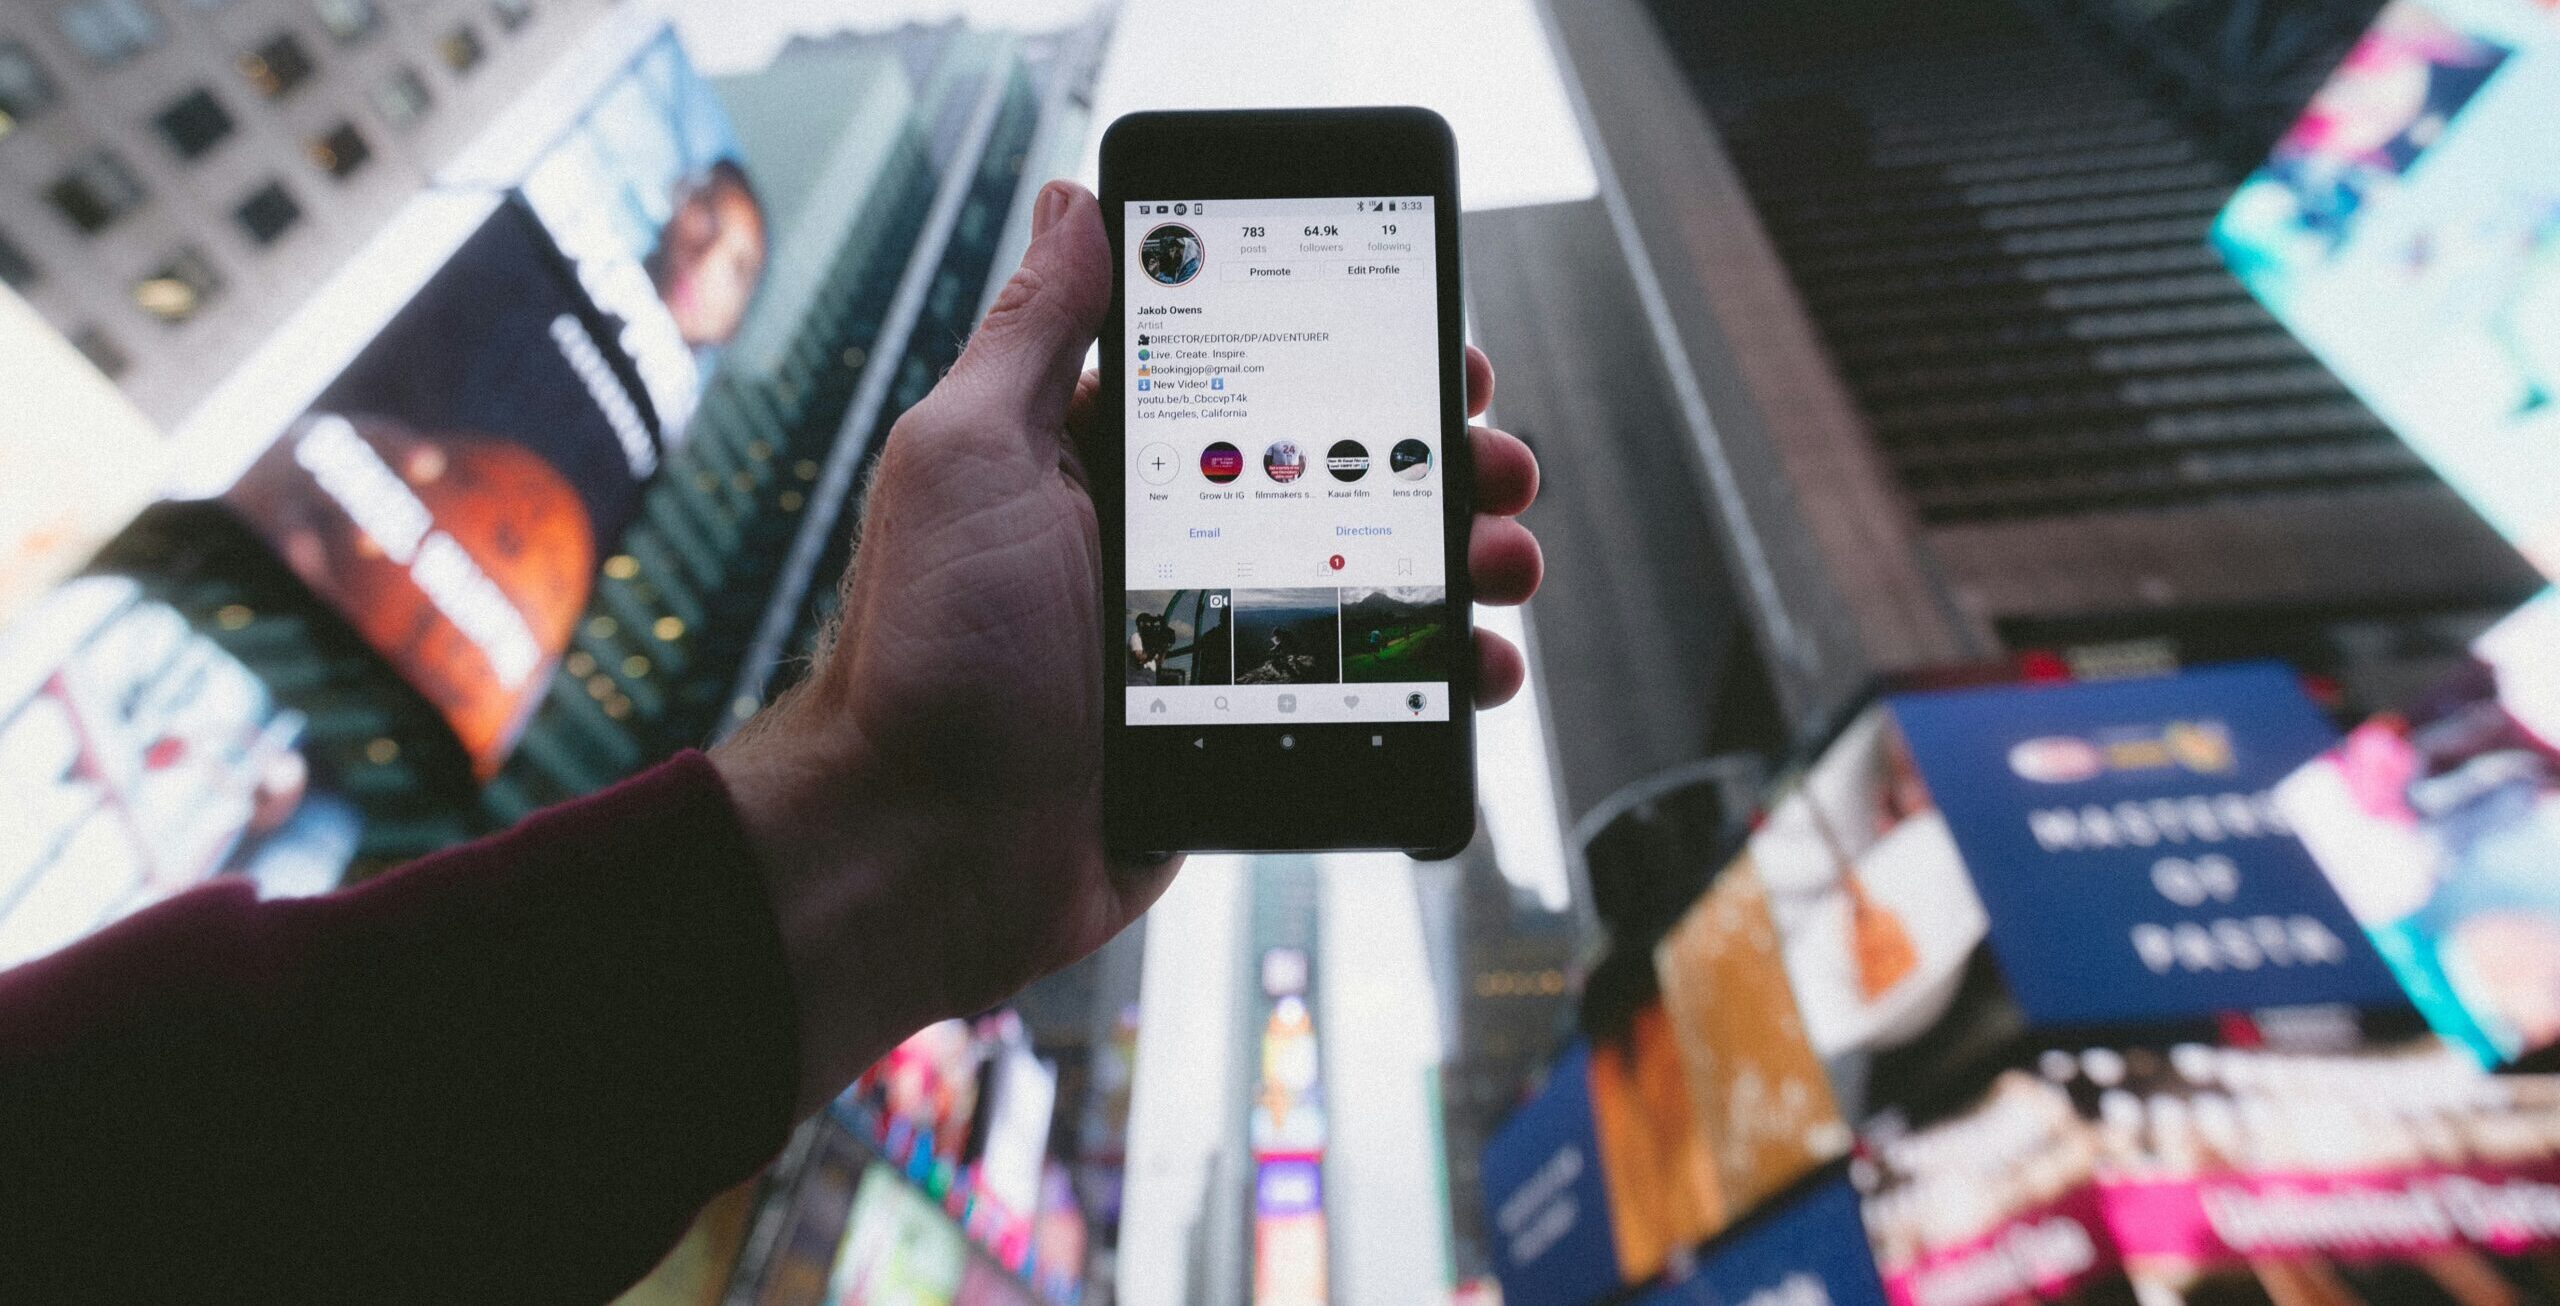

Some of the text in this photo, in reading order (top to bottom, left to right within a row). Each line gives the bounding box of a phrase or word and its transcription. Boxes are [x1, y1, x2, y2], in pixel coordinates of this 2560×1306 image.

[1401, 201, 1423, 211] 3:33
[1241, 226, 1265, 238] 783
[1303, 224, 1339, 237] 64.9k
[1381, 224, 1397, 236] 19
[1240, 244, 1267, 255] posts
[1299, 243, 1344, 253] followers
[1367, 241, 1411, 253] following
[1249, 267, 1291, 277] Promote
[1347, 264, 1401, 275] Edit Profile
[1137, 305, 1203, 315] Jakob Owens
[1137, 321, 1164, 330] Artist
[1150, 332, 1330, 344] DIRECTOR/EDITOR/DP/ADVENTURER
[1150, 348, 1248, 360] Live. Create. Inspire.
[1150, 363, 1265, 377] Bookingjop@gmail.com
[1153, 379, 1208, 390] New Video!
[1137, 407, 1248, 420] Los Angeles, California
[1282, 444, 1296, 455] 24
[1149, 492, 1169, 501] New
[1199, 490, 1245, 500] Grow Ur IG
[1255, 490, 1302, 499] filmmakers
[1327, 488, 1370, 499] Kauai film
[1392, 487, 1433, 498] lens drop
[1189, 527, 1221, 538] Email
[1335, 525, 1393, 537] Directions
